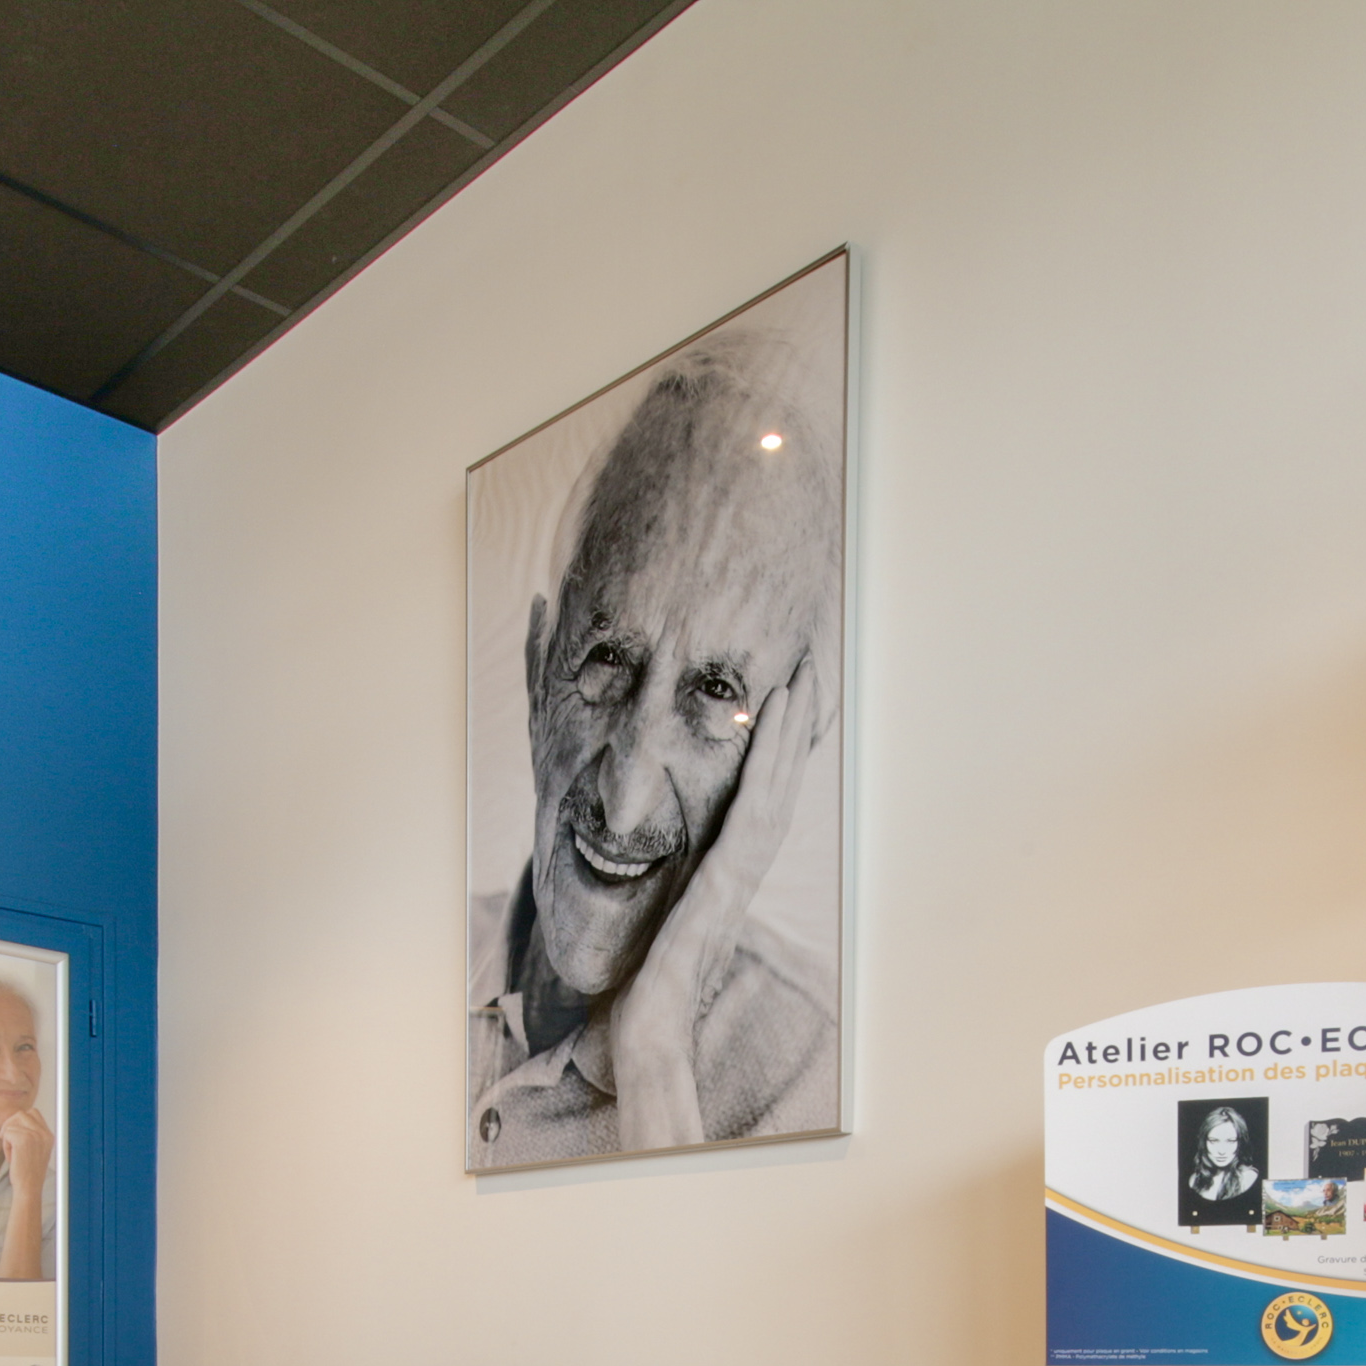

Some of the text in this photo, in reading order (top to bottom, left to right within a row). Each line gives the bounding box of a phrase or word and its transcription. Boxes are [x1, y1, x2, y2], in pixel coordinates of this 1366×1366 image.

[1058, 1037, 1188, 1065] Atelier
[1059, 1065, 1254, 1089] Personnalisation
[1263, 1063, 1306, 1080] des
